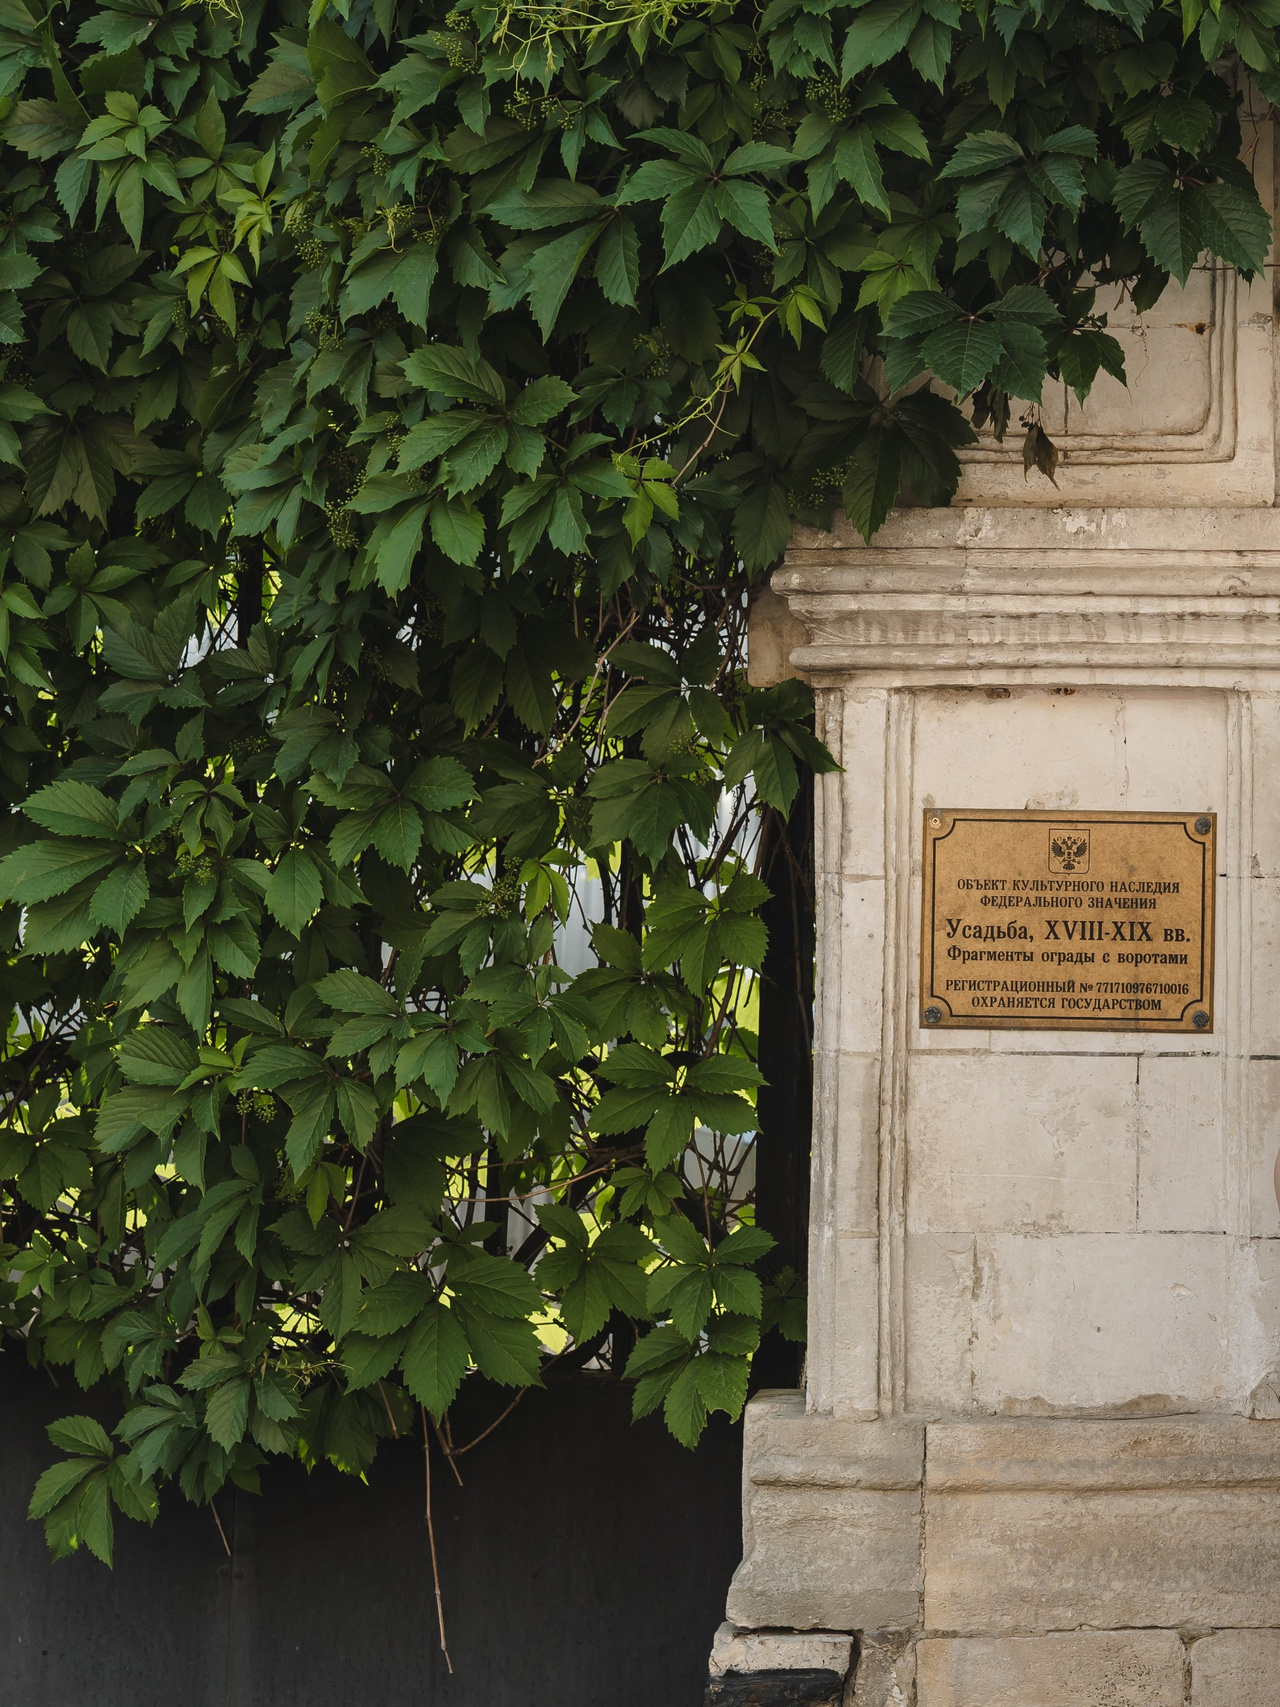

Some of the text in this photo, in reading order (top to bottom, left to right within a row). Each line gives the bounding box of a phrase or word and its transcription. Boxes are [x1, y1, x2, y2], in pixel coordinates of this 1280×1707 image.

[957, 878, 1180, 894] ОБЪЕКТ КУЛЬТУРНОГО НАСЛЕДИЯ
[980, 895, 1157, 909] ФЕДЕРАЛЬНОГО ЗНАЧЕНИЯ
[946, 918, 1034, 941] Усадьба,
[1163, 928, 1191, 942] вв.
[947, 945, 1188, 966] Фрагменты ограды с воротами
[945, 979, 1076, 994] РЕГИСТРАЦИОННЫЙ
[1096, 982, 1189, 995] 771710976710016
[971, 996, 1162, 1012] ОХРАНЯЕТСЯ ГОСУДАРСТВОМ
